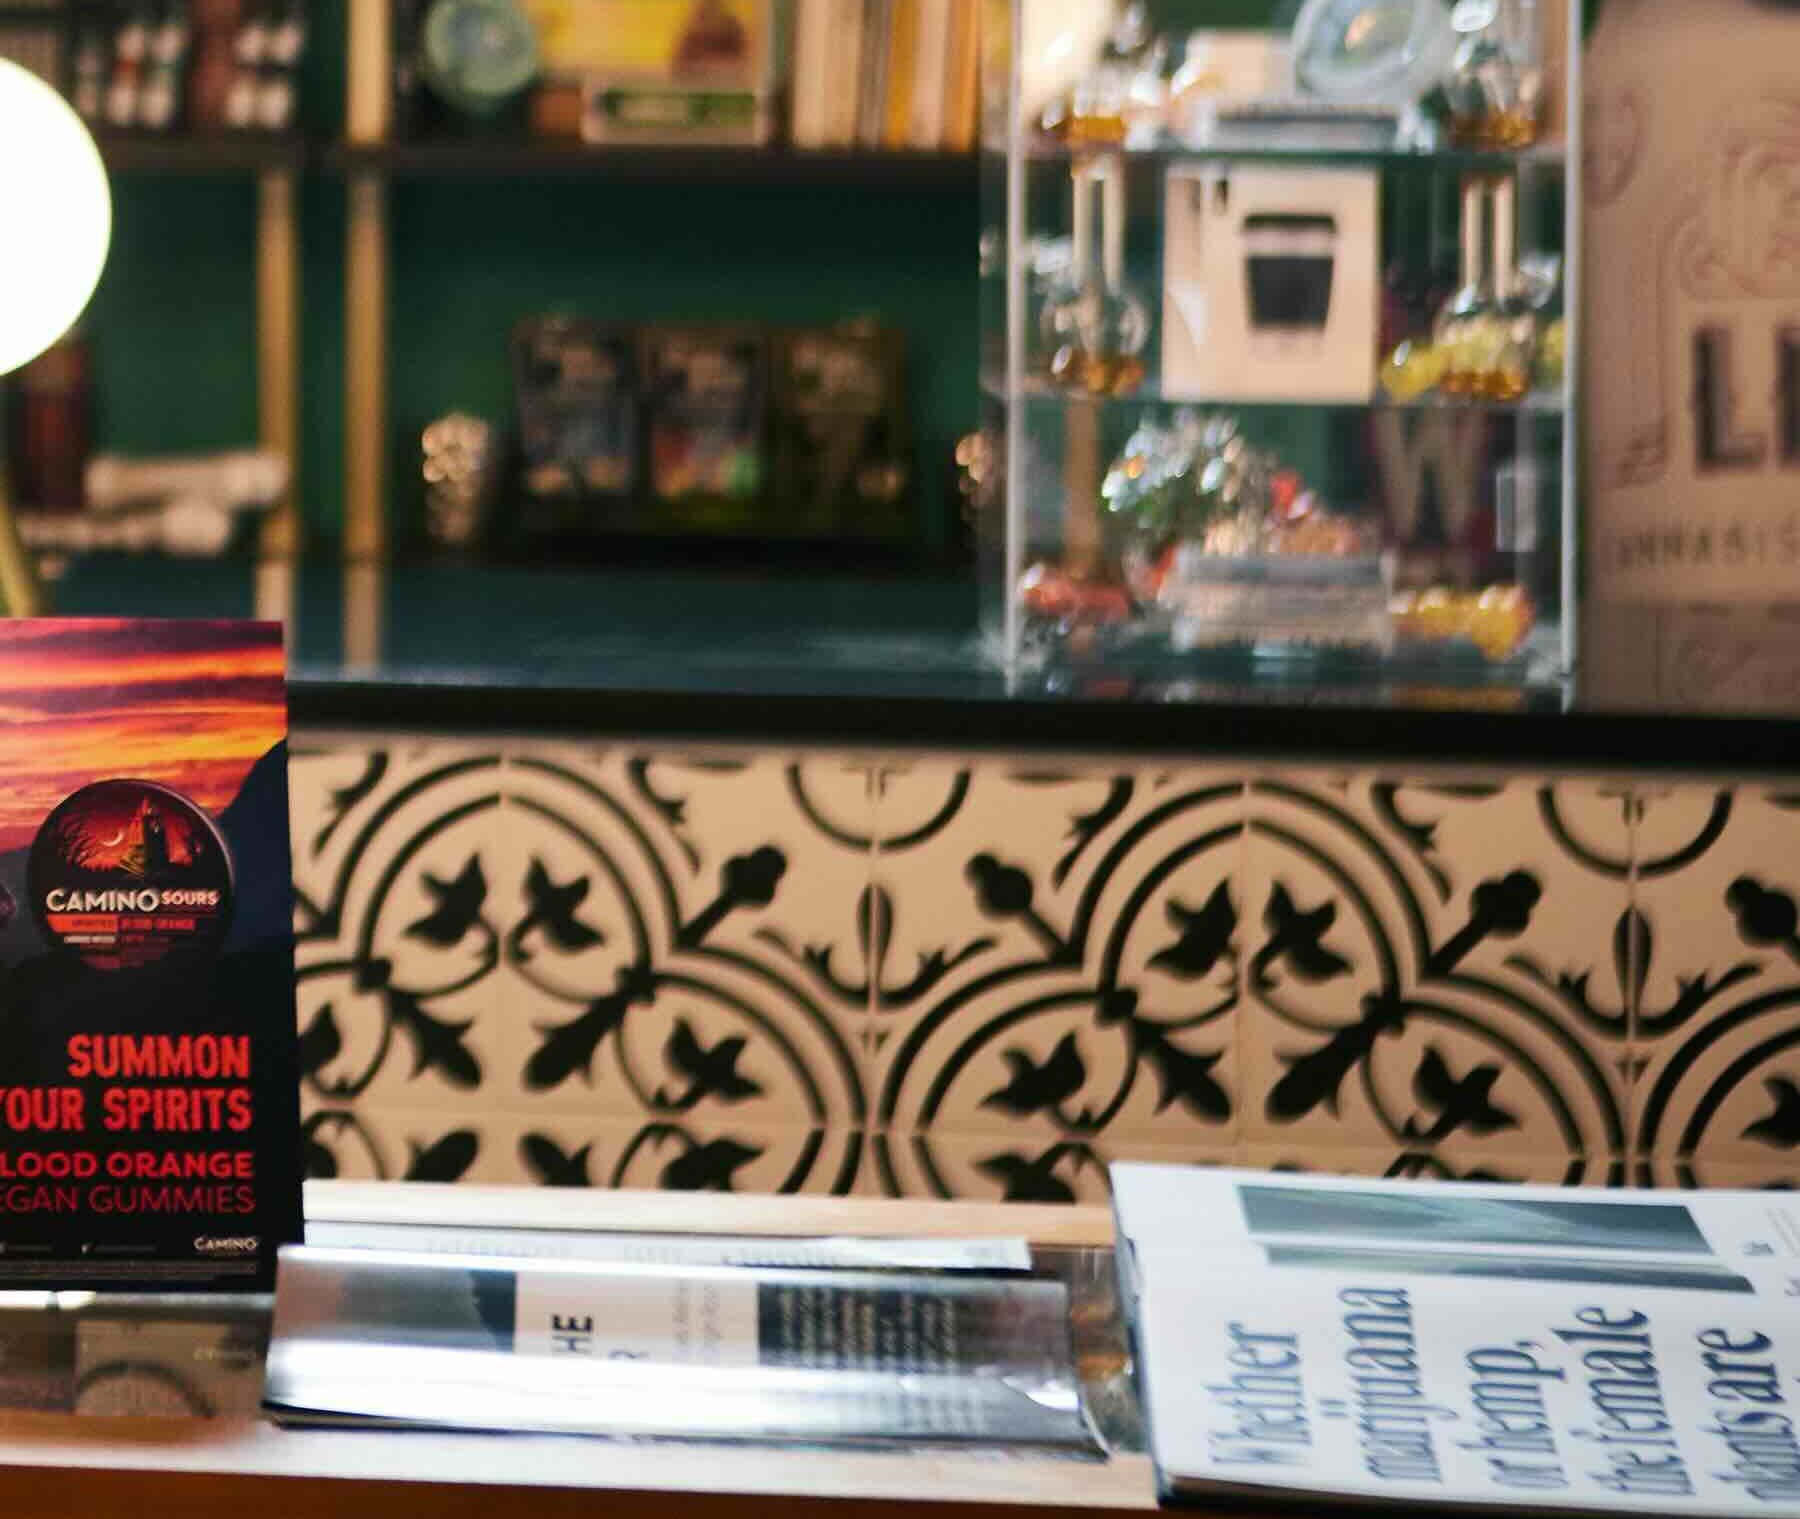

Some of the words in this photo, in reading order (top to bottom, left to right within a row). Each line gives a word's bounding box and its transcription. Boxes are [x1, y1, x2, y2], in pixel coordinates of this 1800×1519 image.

[46, 888, 160, 913] CAMINO
[161, 888, 221, 907] SOURS
[66, 1033, 251, 1080] SUMMON
[102, 1086, 253, 1132] SPIRITS
[106, 1151, 255, 1179] ORANGE
[87, 1184, 256, 1213] GUMMIES
[194, 1237, 257, 1251] CAMINO
[1318, 1287, 1459, 1483] marijuana
[1550, 1306, 1676, 1449] female
[1697, 1328, 1787, 1406] are
[1455, 1339, 1568, 1454] hemp,
